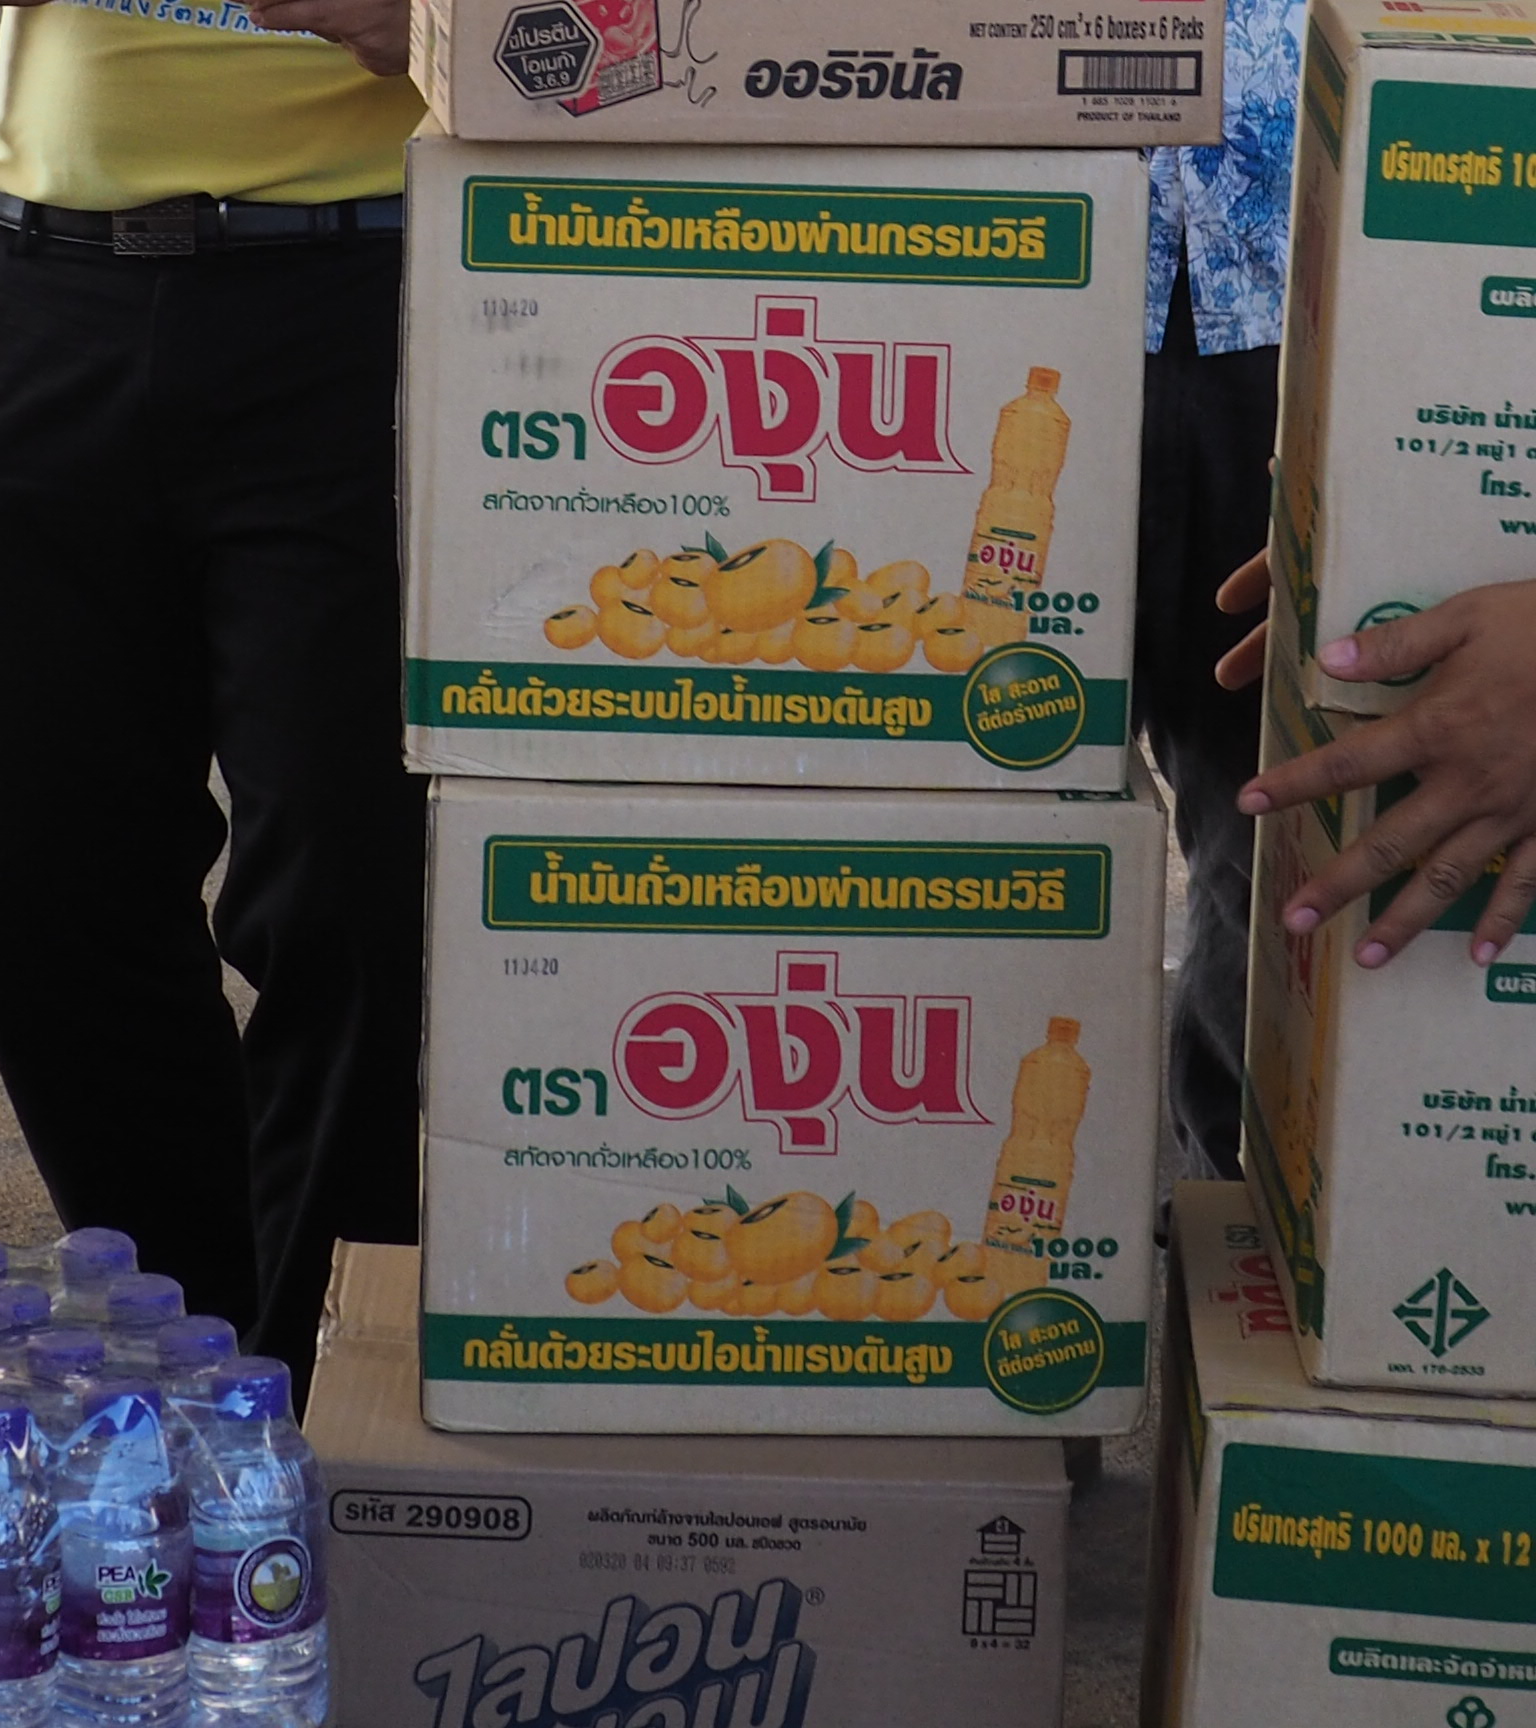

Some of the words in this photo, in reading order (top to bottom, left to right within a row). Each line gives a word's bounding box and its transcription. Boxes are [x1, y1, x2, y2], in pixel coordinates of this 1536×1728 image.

[969, 22, 986, 38] NET
[988, 22, 1028, 39] CONTENT
[1030, 14, 1054, 39] 250
[1107, 15, 1146, 40] boxes
[1171, 15, 1204, 41] Packs
[744, 49, 963, 102] ออริจินัล
[1382, 140, 1504, 197] ปริมาตรสุทธิ
[508, 191, 1046, 261] น้ำมันถั่วเหลืองผ่านกรรมวิธี
[480, 409, 587, 460] ตรา
[592, 295, 972, 502] องุ่น
[1417, 403, 1486, 429] บริษัท
[1480, 471, 1531, 499] โทร.
[482, 488, 731, 518] สกัดจากถั่วเหลือง100%
[978, 541, 1036, 574] องุ่น
[1011, 590, 1100, 614] 1000
[1029, 616, 1085, 636] มล.
[442, 669, 933, 737] กลั่นด้วยระบบไอน้ำแรงดันสูง
[528, 851, 1066, 912] น้ำมันถั่วเหลืองผ่านกรรมวิธี
[501, 1068, 608, 1116] ตรา
[613, 951, 994, 1156] องุ่น
[1424, 1088, 1493, 1112] บริษัท
[1401, 1122, 1476, 1143] 101/2
[503, 1142, 752, 1173] สกัดจากถั่วเหลือง100%
[1486, 1154, 1536, 1182] โทร.
[999, 1189, 1056, 1222] องุ่น
[1031, 1237, 1120, 1259] 1000
[1049, 1261, 1104, 1280] มล.
[464, 1322, 953, 1386] กลั่นด้วยระบบไอน้ำแรงดันสูง
[344, 1494, 396, 1524] รหัส
[406, 1504, 521, 1532] 290908
[688, 1532, 719, 1548] 500
[1233, 1503, 1354, 1561] ปริมาตรสุทธิ
[1363, 1520, 1423, 1558] 1000
[1431, 1530, 1467, 1563] มล.
[1501, 1532, 1531, 1567] 12
[98, 1565, 136, 1583] PEA
